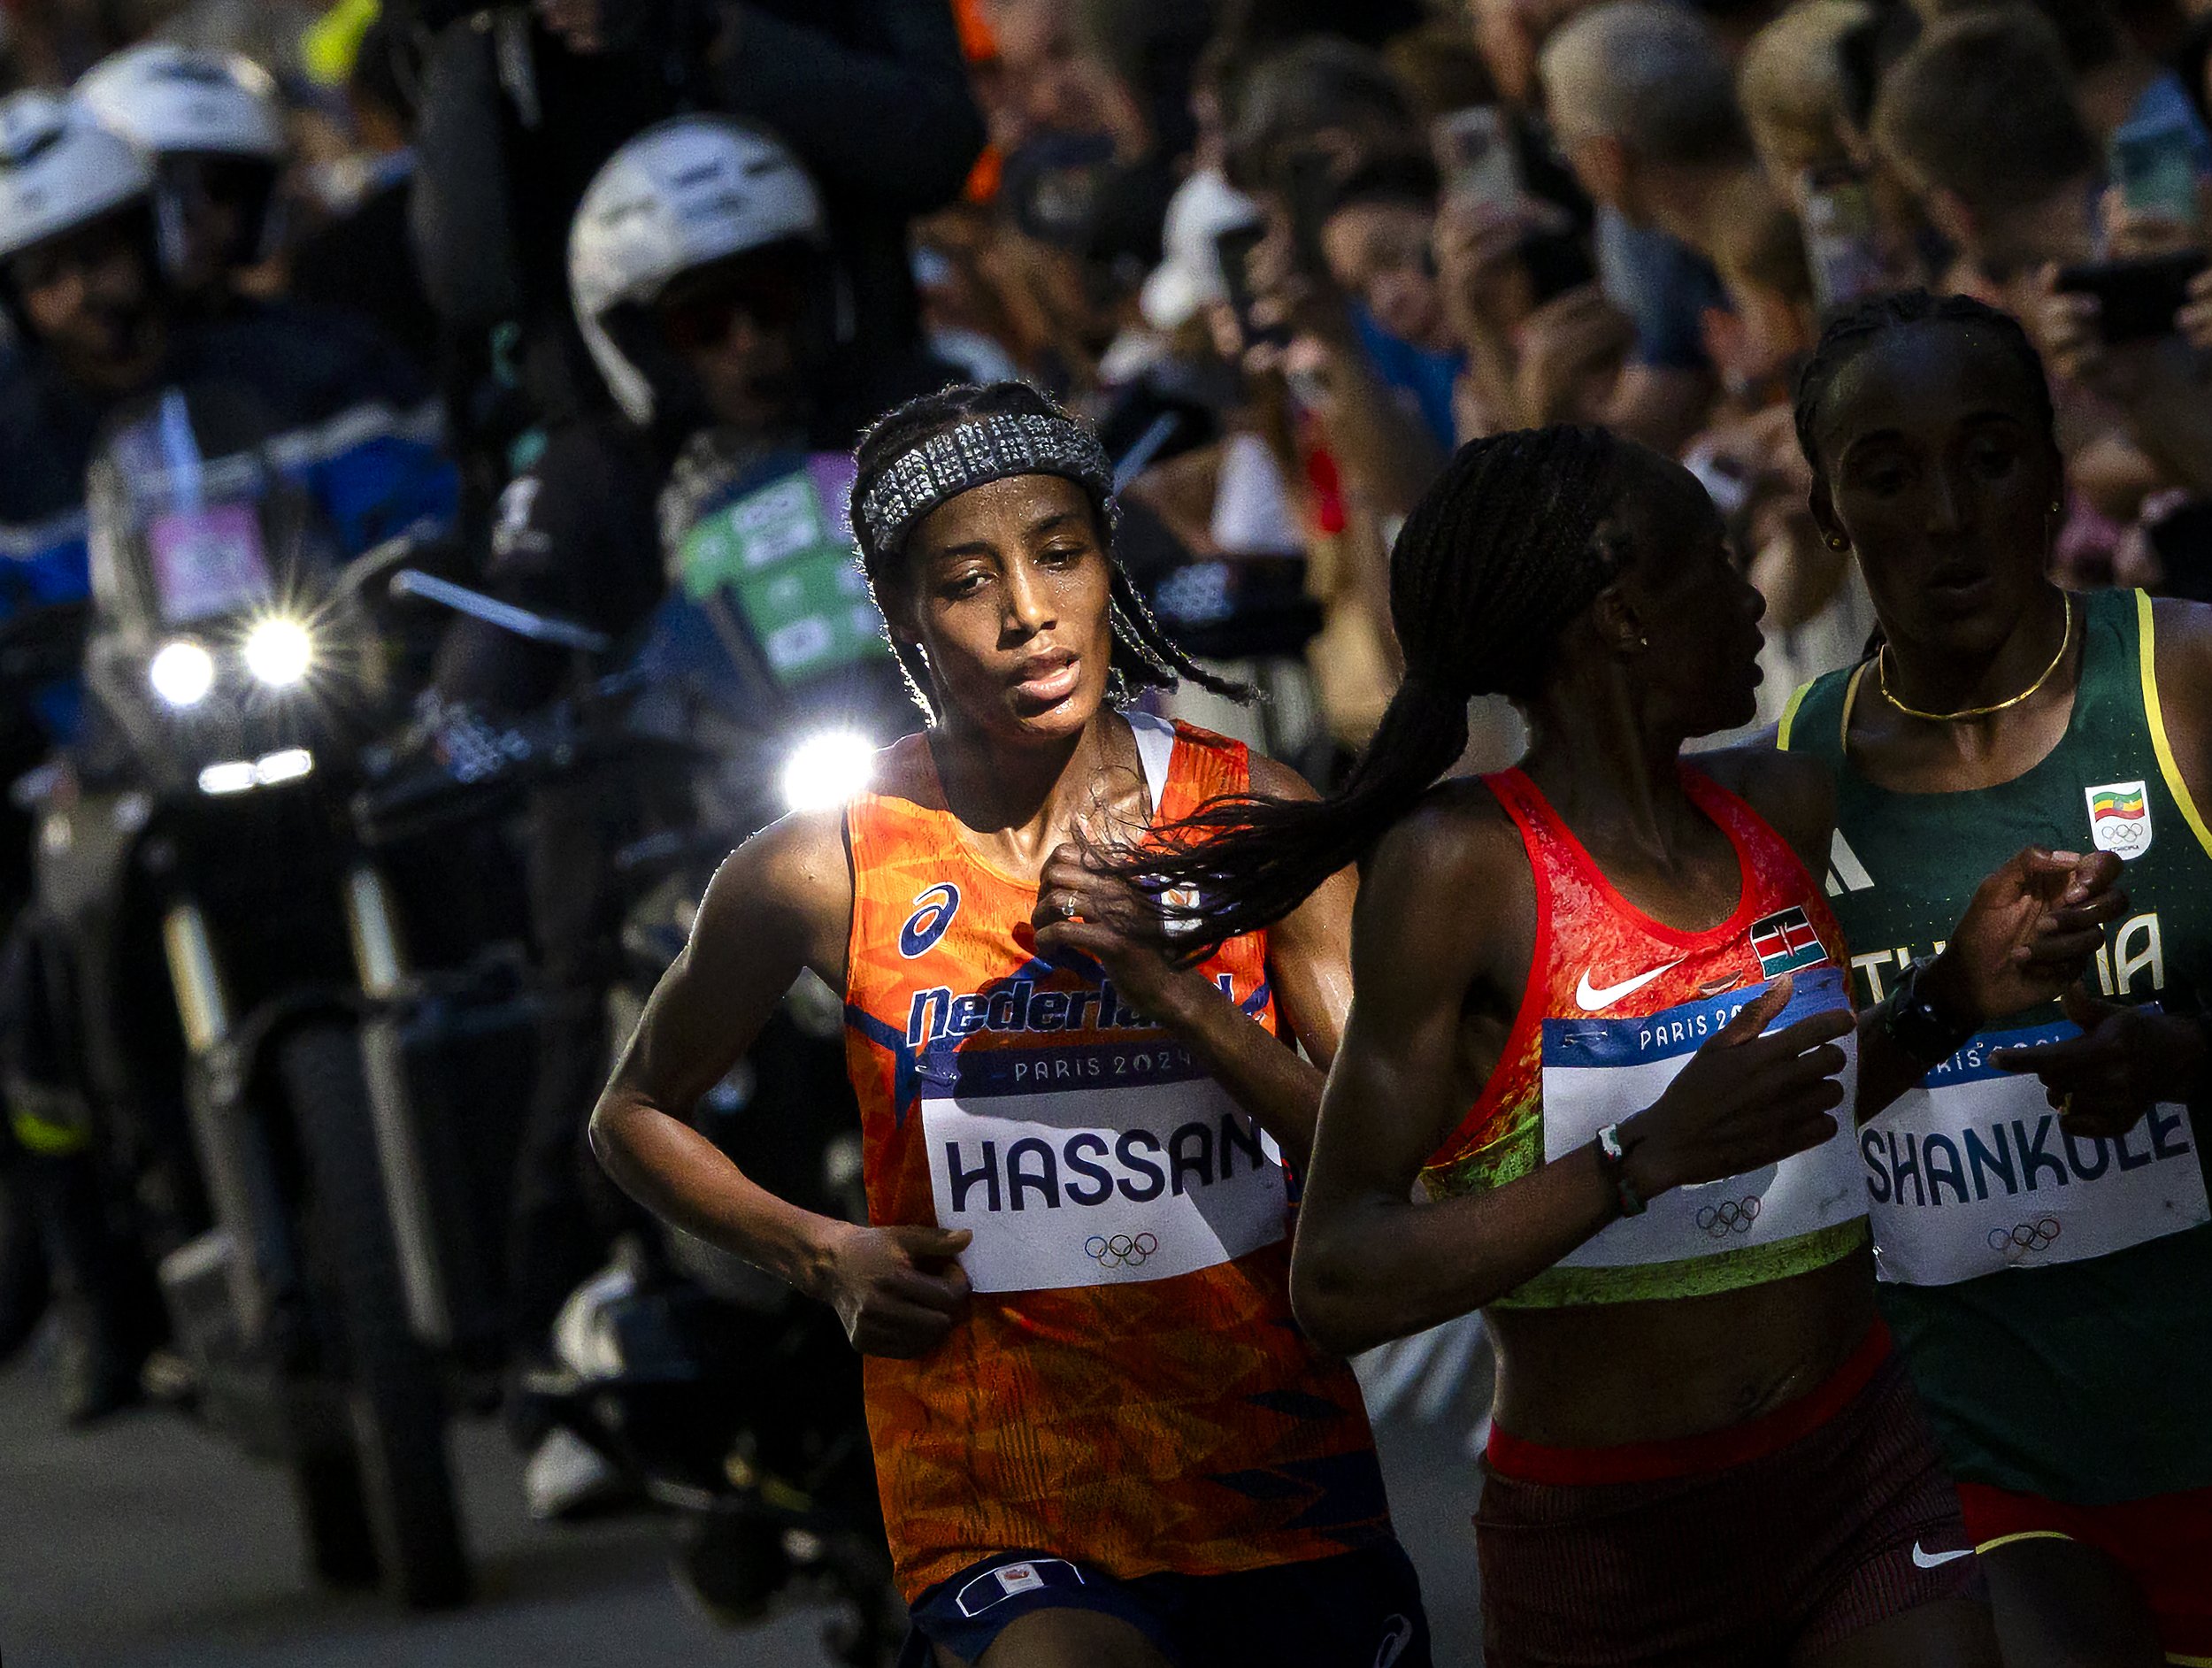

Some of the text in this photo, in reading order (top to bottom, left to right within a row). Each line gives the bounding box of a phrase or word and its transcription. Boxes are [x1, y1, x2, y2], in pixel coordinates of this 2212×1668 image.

[1640, 1016, 1708, 1050] PARIS
[1014, 1049, 1191, 1081] PARIS 2024
[944, 1112, 1263, 1212] HASSAN
